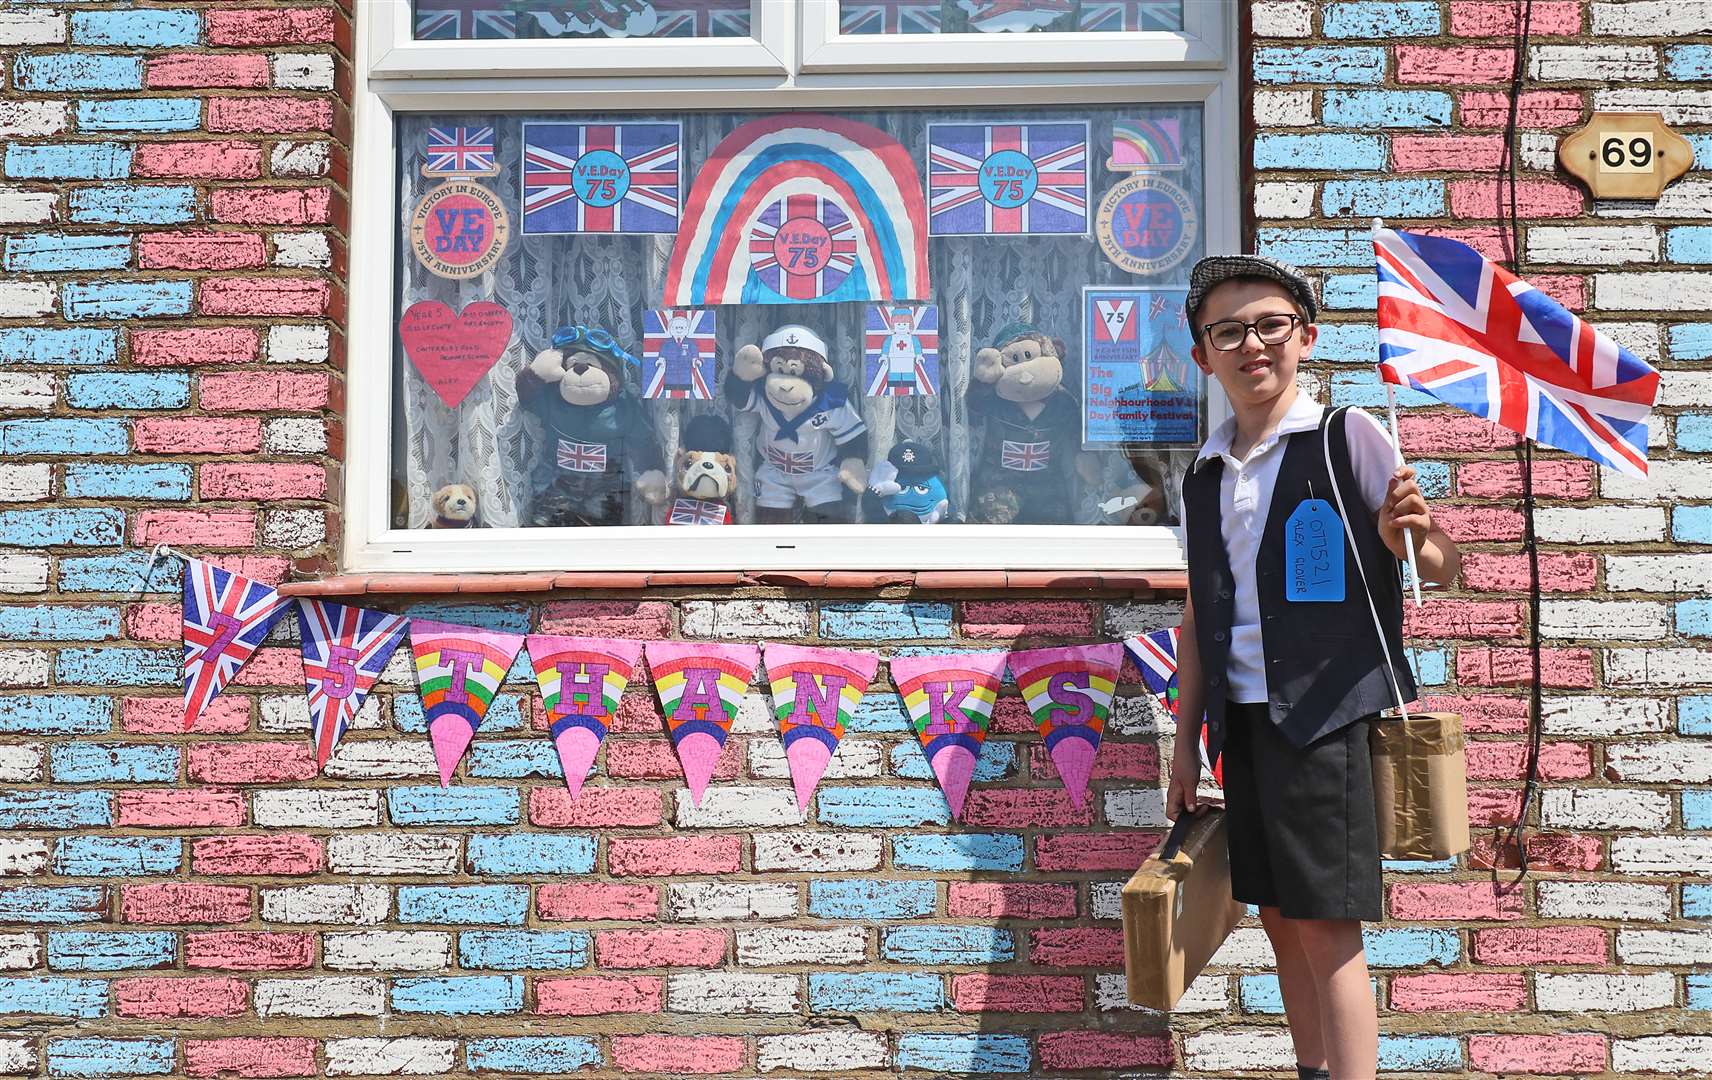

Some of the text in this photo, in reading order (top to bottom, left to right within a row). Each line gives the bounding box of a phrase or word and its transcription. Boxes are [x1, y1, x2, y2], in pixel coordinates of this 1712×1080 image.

[1602, 138, 1652, 167] 69
[578, 165, 625, 179] V.E.Day
[984, 166, 1032, 179] V.E.Day
[586, 179, 616, 200] 75
[993, 180, 1024, 200] 75
[1104, 180, 1140, 213] VICTORY
[1157, 181, 1191, 213] EUROPE
[417, 185, 502, 219] VICTORY IN EUROPE
[435, 208, 484, 238] VE
[1121, 203, 1173, 229] VE
[435, 236, 481, 252] DAY
[1123, 230, 1169, 247] DAY
[416, 239, 502, 274] 75TH ANNIVERSARY
[788, 248, 819, 268] 75
[1103, 233, 1192, 270] 75TH ANNIVERSARY
[1106, 312, 1124, 323] 75
[1090, 367, 1113, 378] The
[1091, 383, 1112, 396] Big
[1090, 396, 1173, 408] Neighbourhood
[1090, 411, 1193, 421] Day Family Festival
[1294, 520, 1305, 547] ALEX
